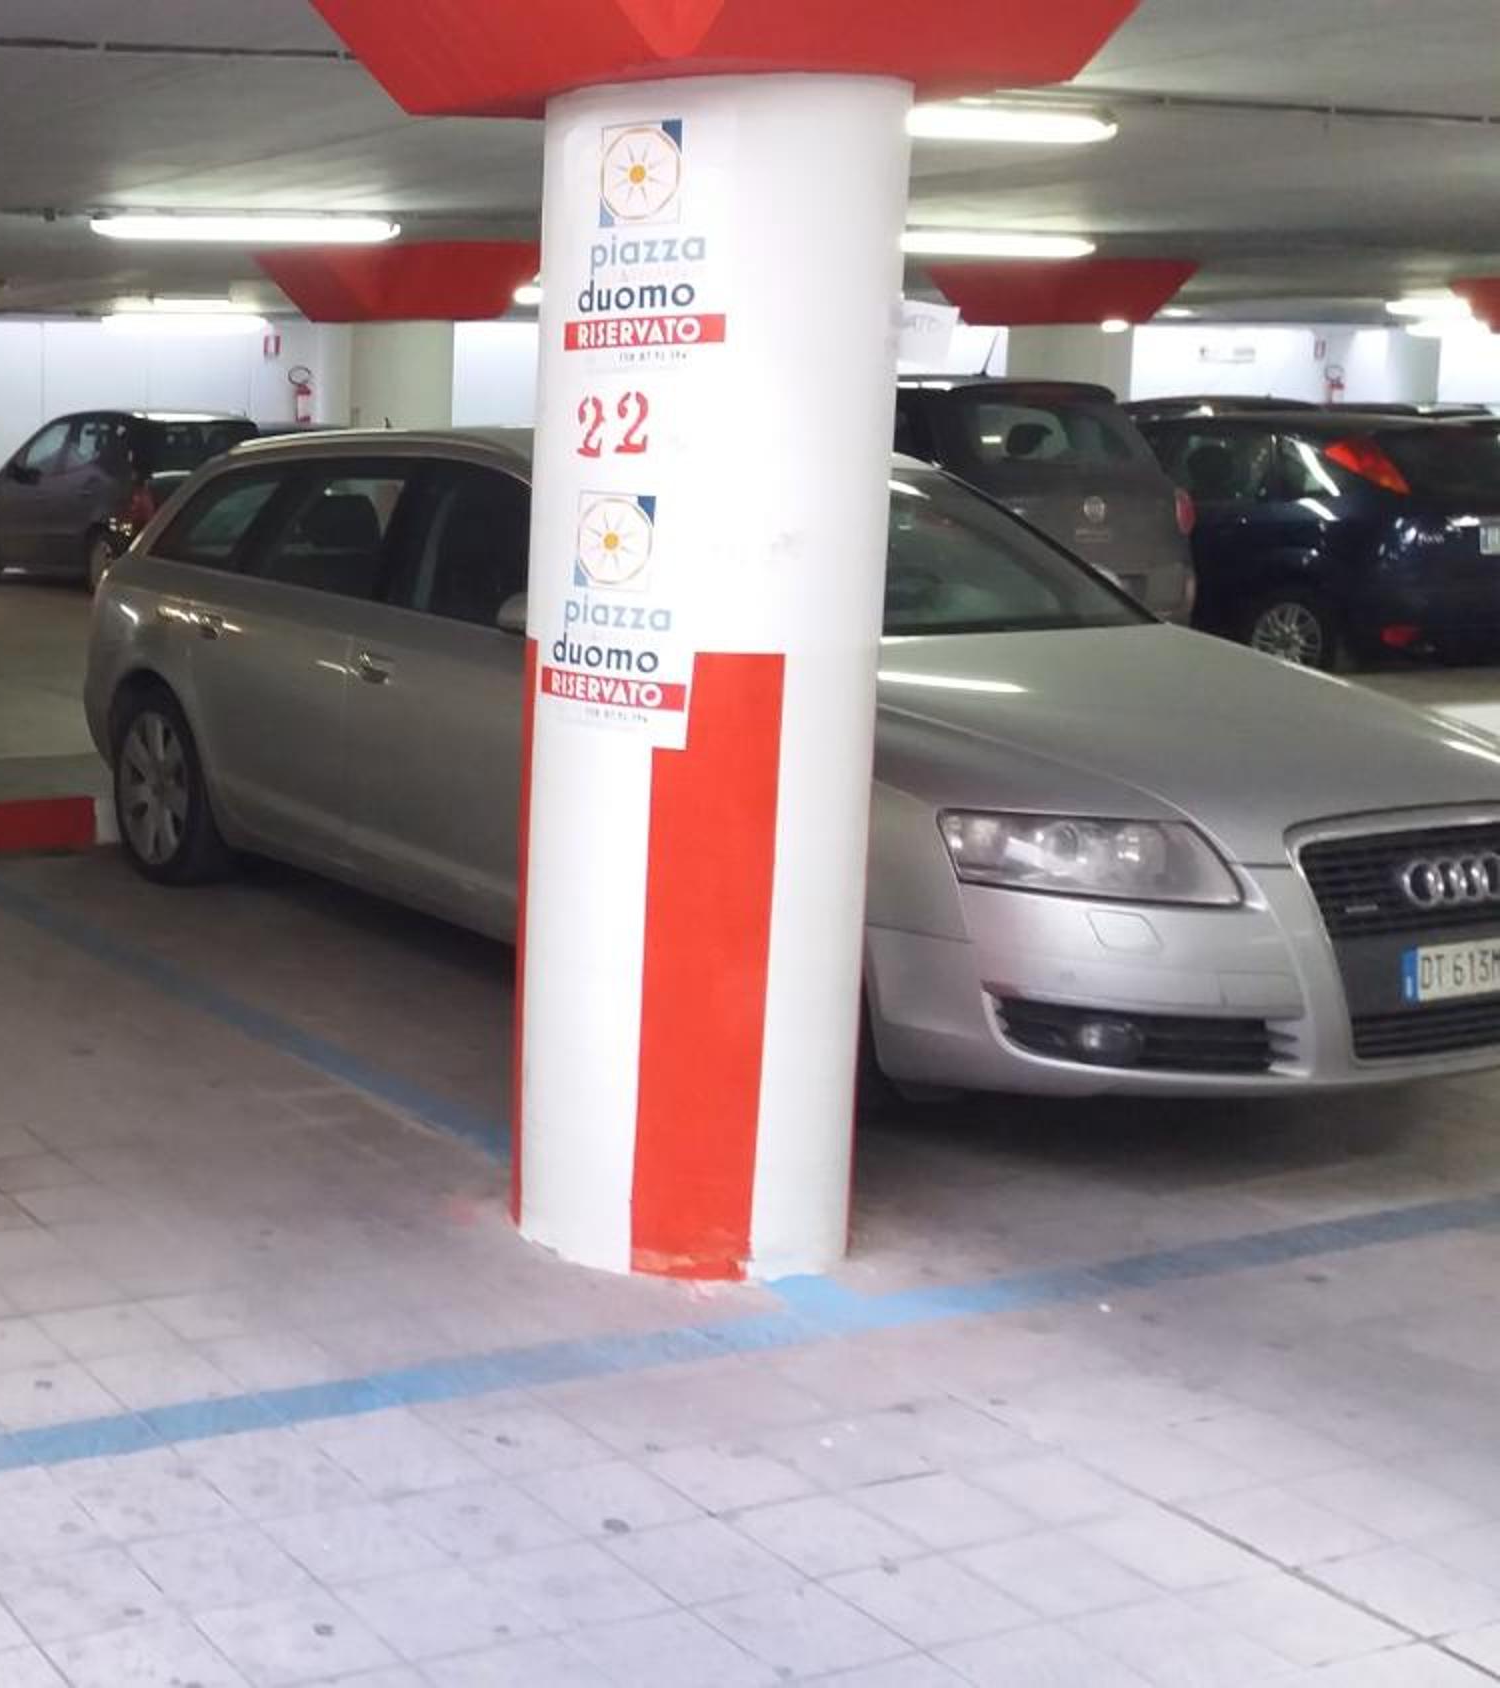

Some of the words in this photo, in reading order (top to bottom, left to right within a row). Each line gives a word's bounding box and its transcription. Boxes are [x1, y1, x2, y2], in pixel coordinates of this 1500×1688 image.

[590, 234, 706, 275] piazza
[578, 279, 695, 312] duomo
[576, 316, 701, 348] RISERVATO
[577, 391, 649, 458] 22
[564, 594, 672, 632] piazza
[552, 632, 660, 673] duomo
[551, 670, 662, 708] RISERVATO
